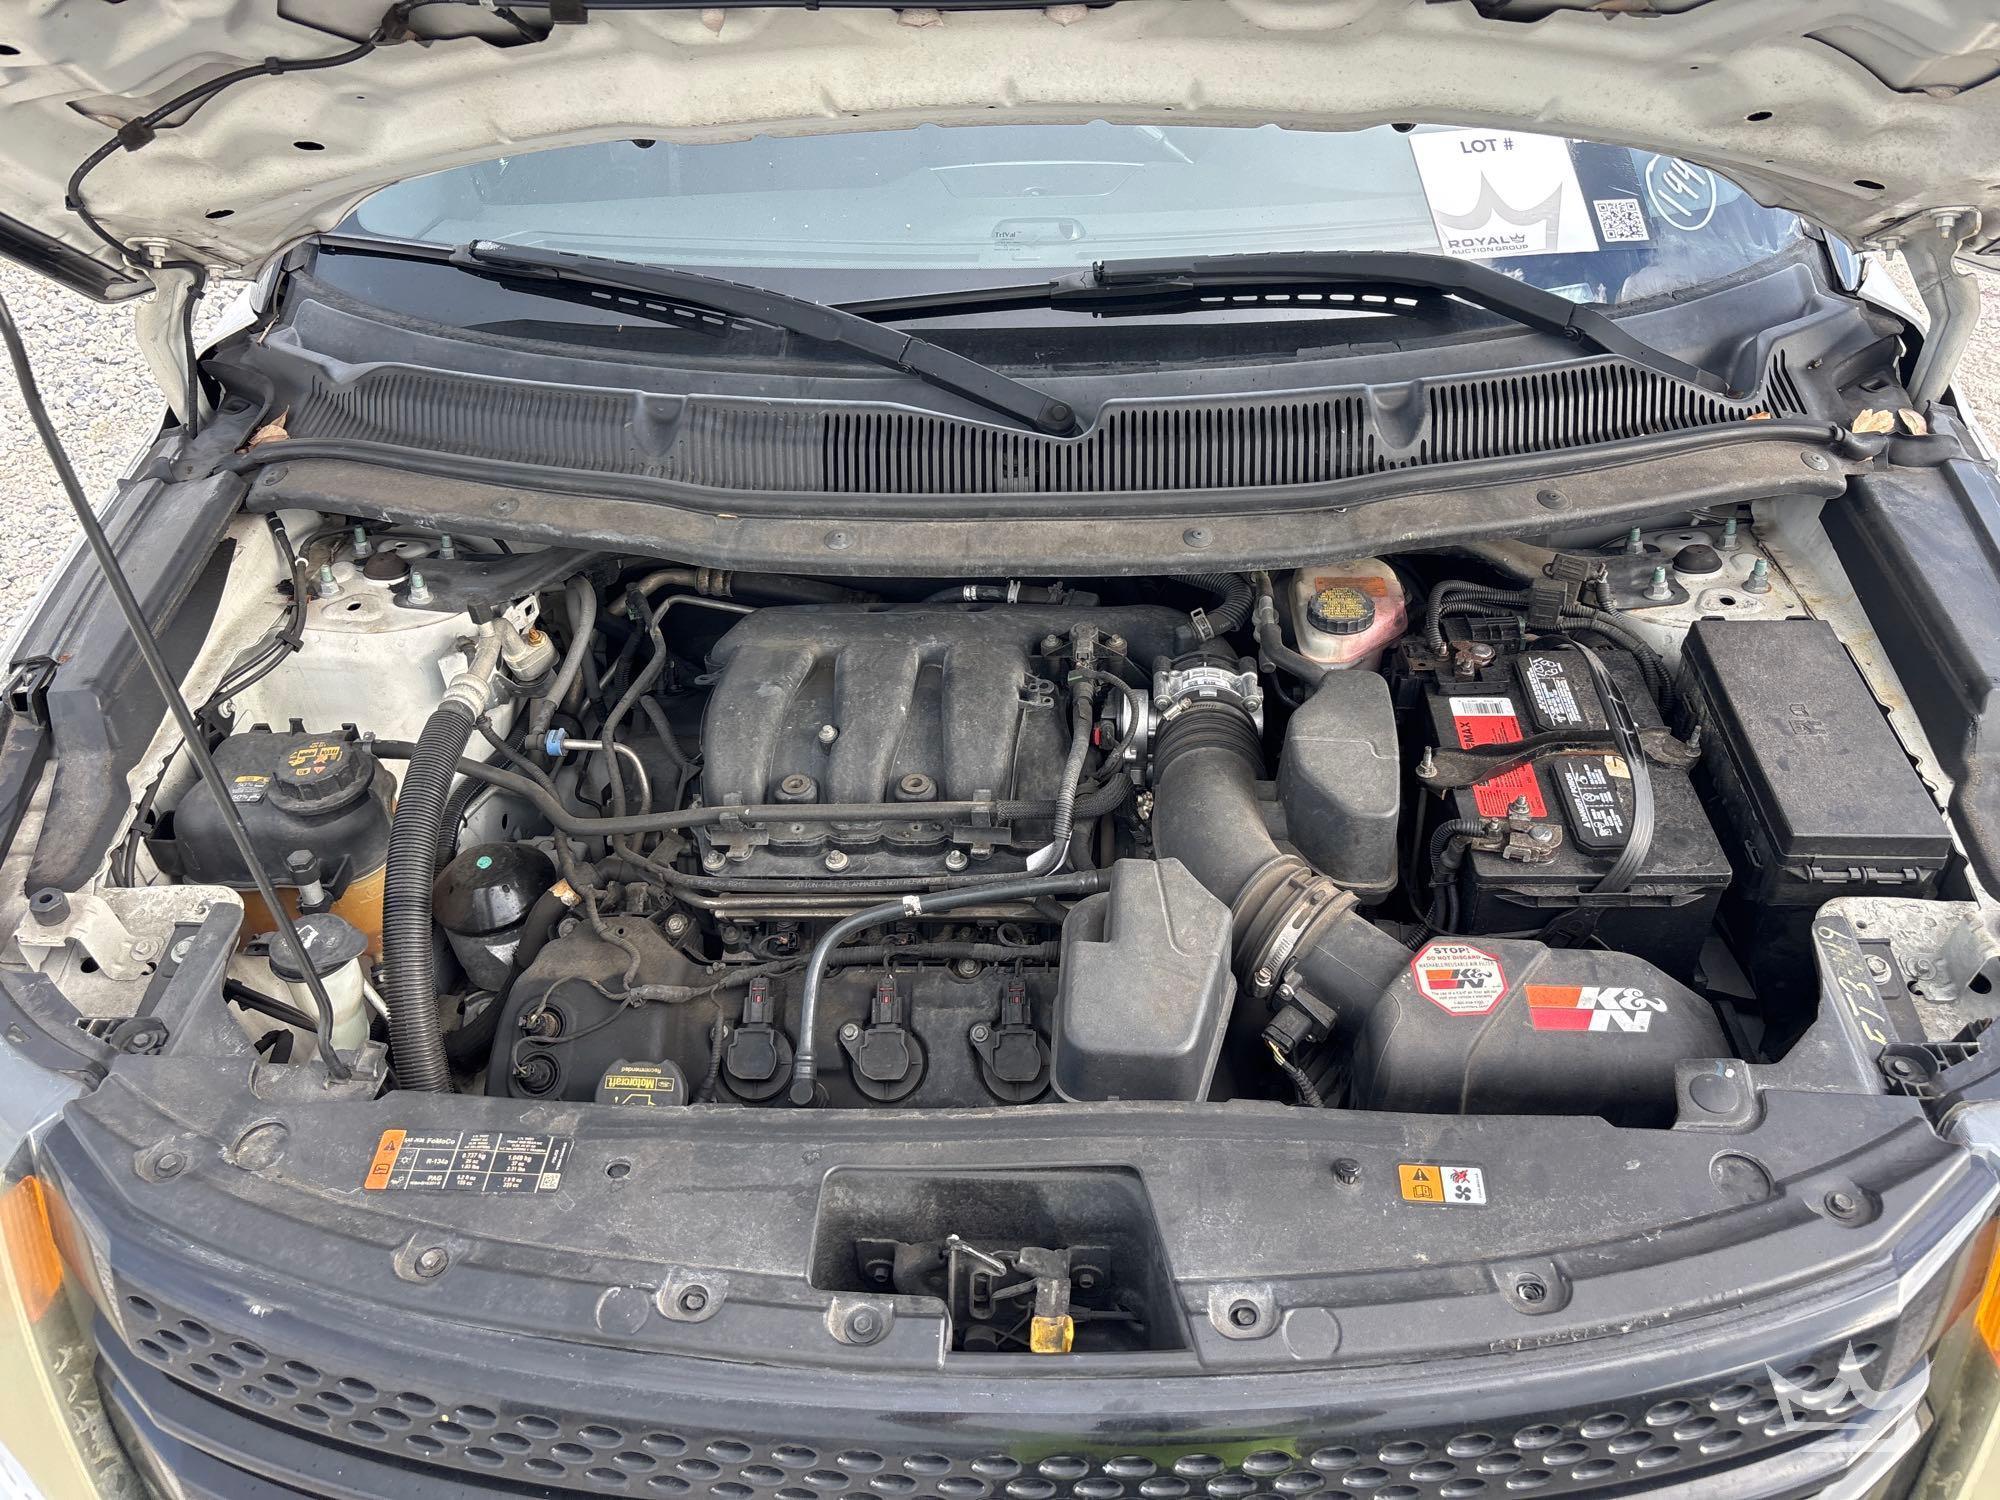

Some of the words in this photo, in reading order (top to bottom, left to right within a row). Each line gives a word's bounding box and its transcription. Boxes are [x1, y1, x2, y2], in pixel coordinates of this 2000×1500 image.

[1460, 138, 1497, 154] LOT
[1503, 136, 1514, 151] #
[1448, 236, 1511, 248] ROYAL
[1452, 246, 1494, 254] AUCTION
[1495, 244, 1529, 252] GROUP
[1450, 968, 1493, 988] K&N
[1576, 986, 1668, 1032] K&N
[621, 1066, 662, 1074] Recommended
[608, 1077, 655, 1089] Motorcraft
